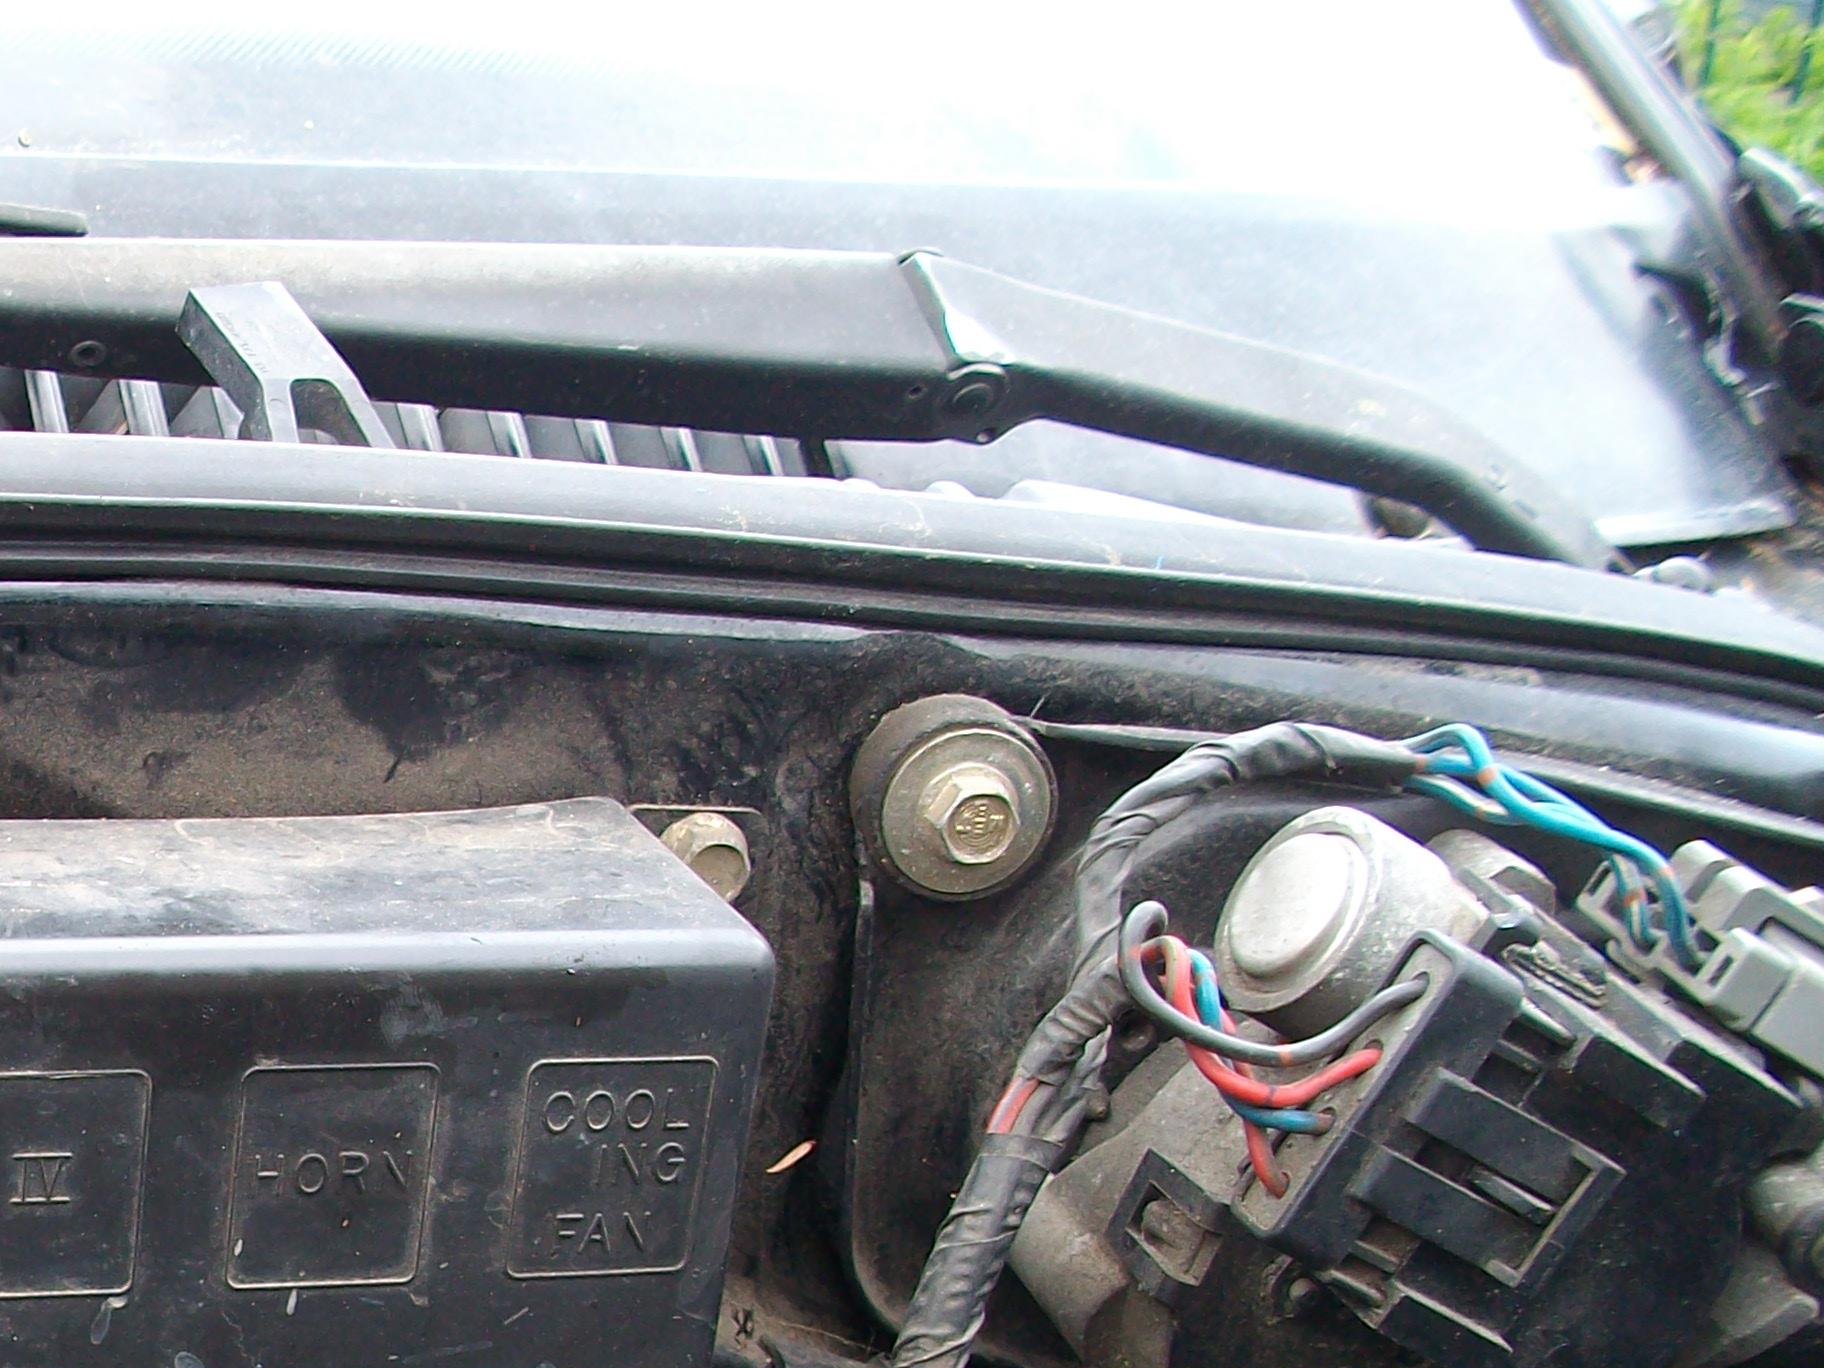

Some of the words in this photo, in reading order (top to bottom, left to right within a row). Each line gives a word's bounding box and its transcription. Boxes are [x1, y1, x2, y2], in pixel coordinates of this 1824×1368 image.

[543, 1088, 691, 1134] COOL
[9, 1150, 74, 1206] IV
[253, 1150, 415, 1195] HORN
[593, 1142, 687, 1188] ING
[551, 1211, 653, 1256] FAN
